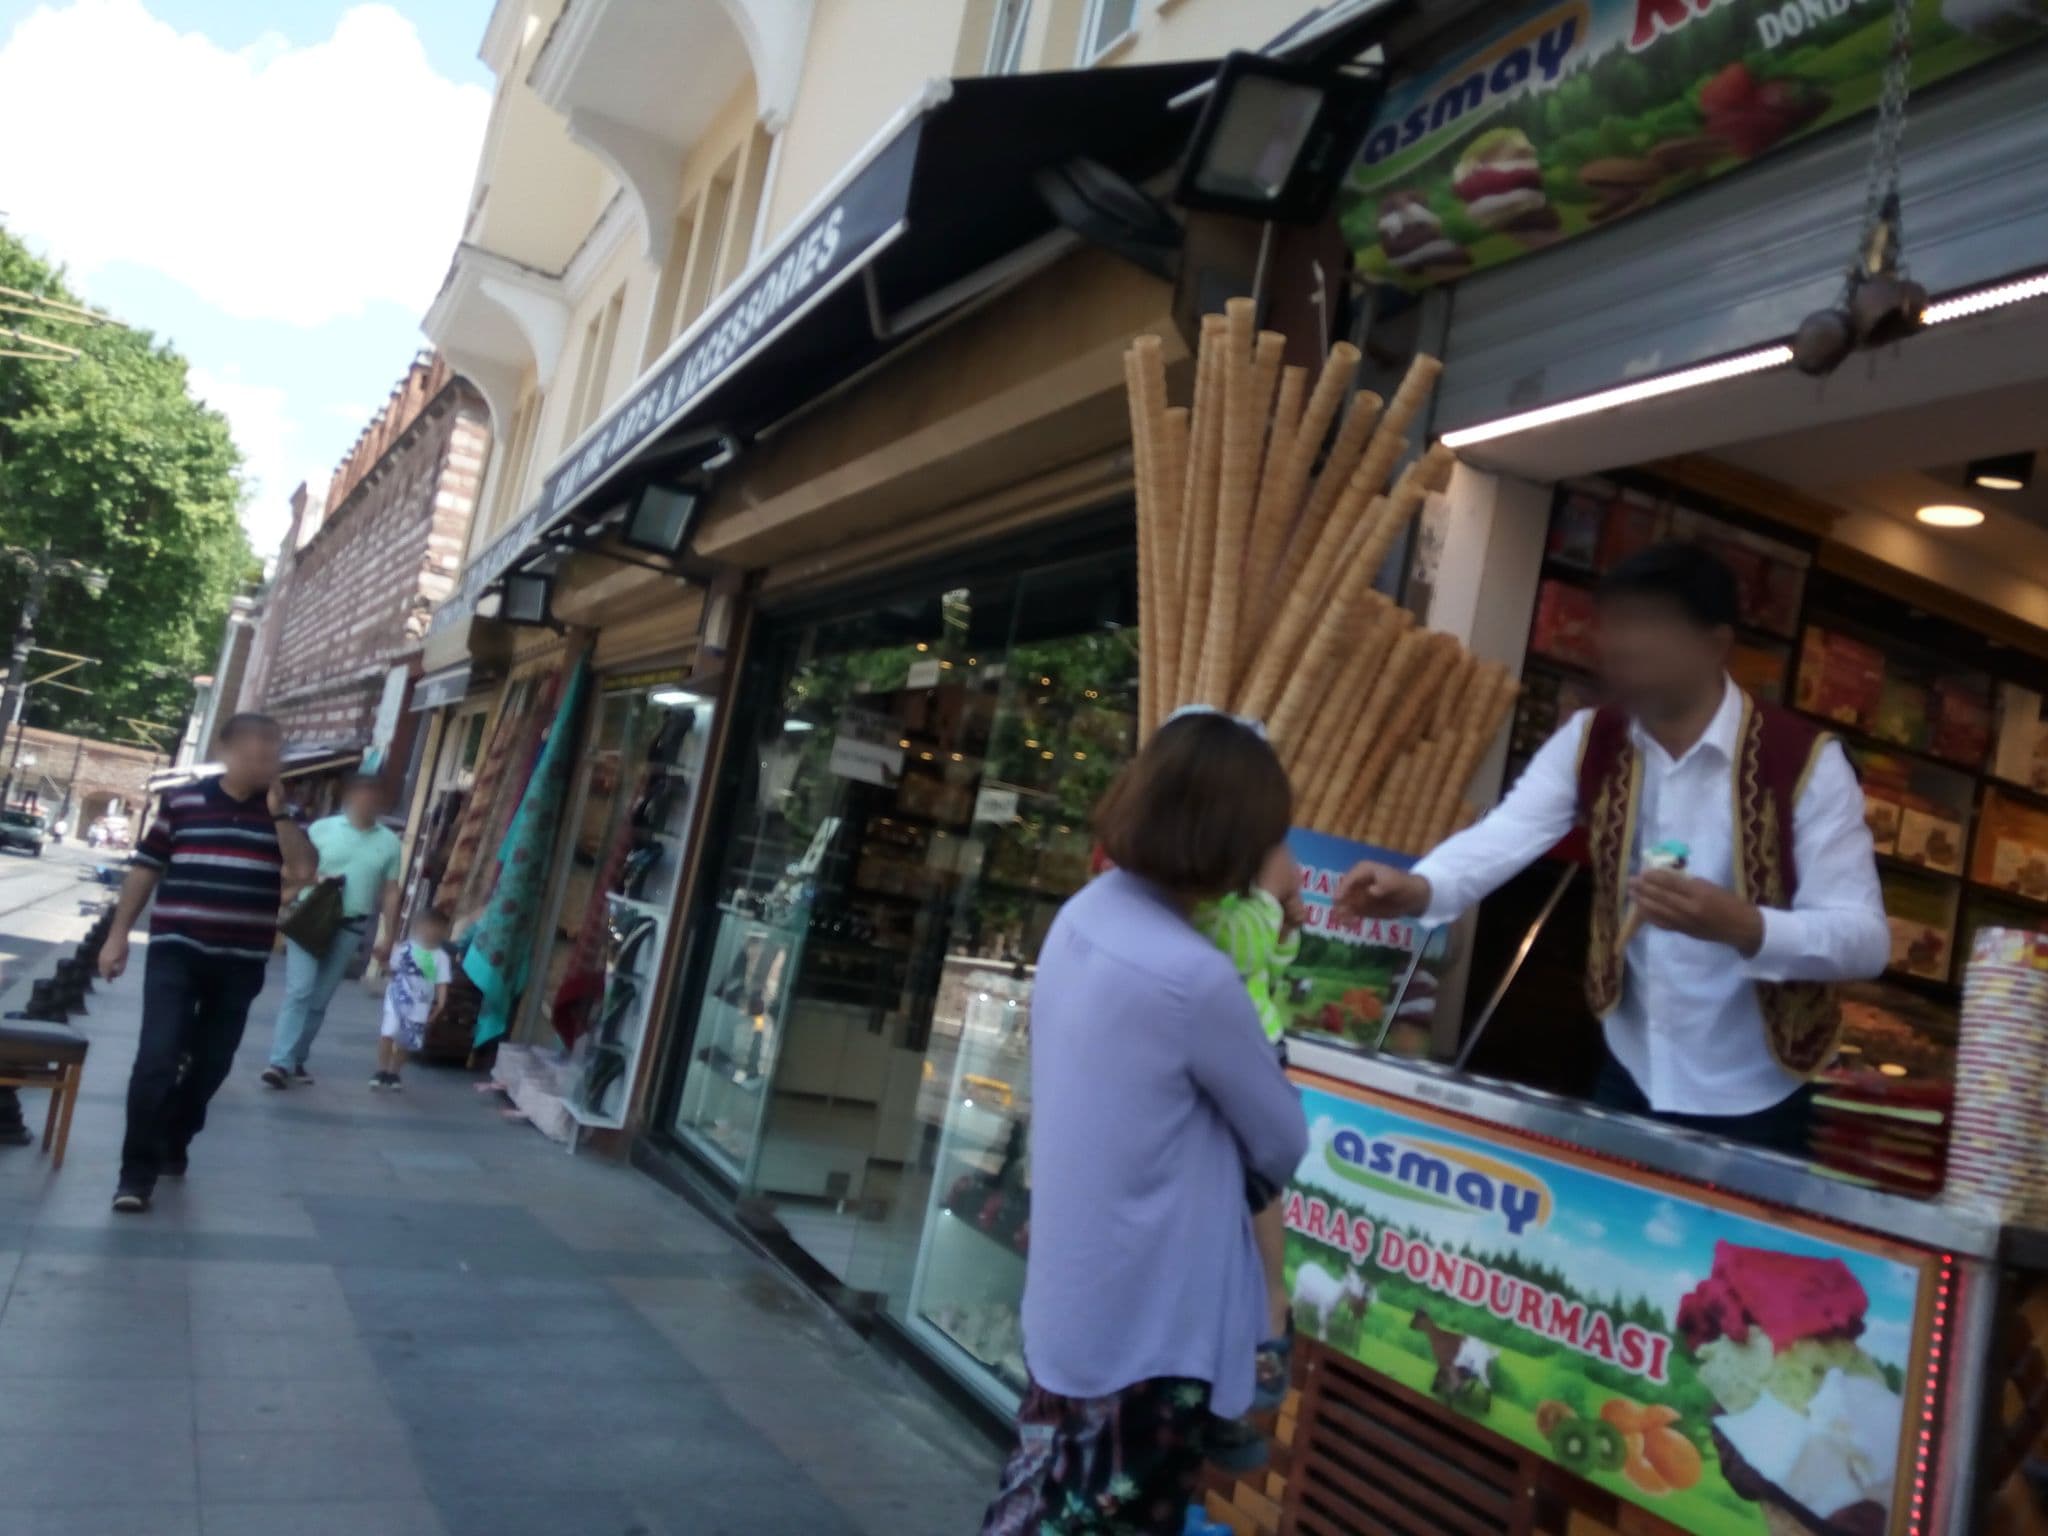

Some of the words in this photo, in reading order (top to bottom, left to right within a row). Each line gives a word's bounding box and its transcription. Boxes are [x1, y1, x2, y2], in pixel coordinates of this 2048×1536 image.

[1363, 15, 1578, 165] asmay
[1333, 1129, 1542, 1234] asmay
[1281, 1191, 1372, 1262] ARAŞ
[1379, 1229, 1671, 1382] DONDURMASI
